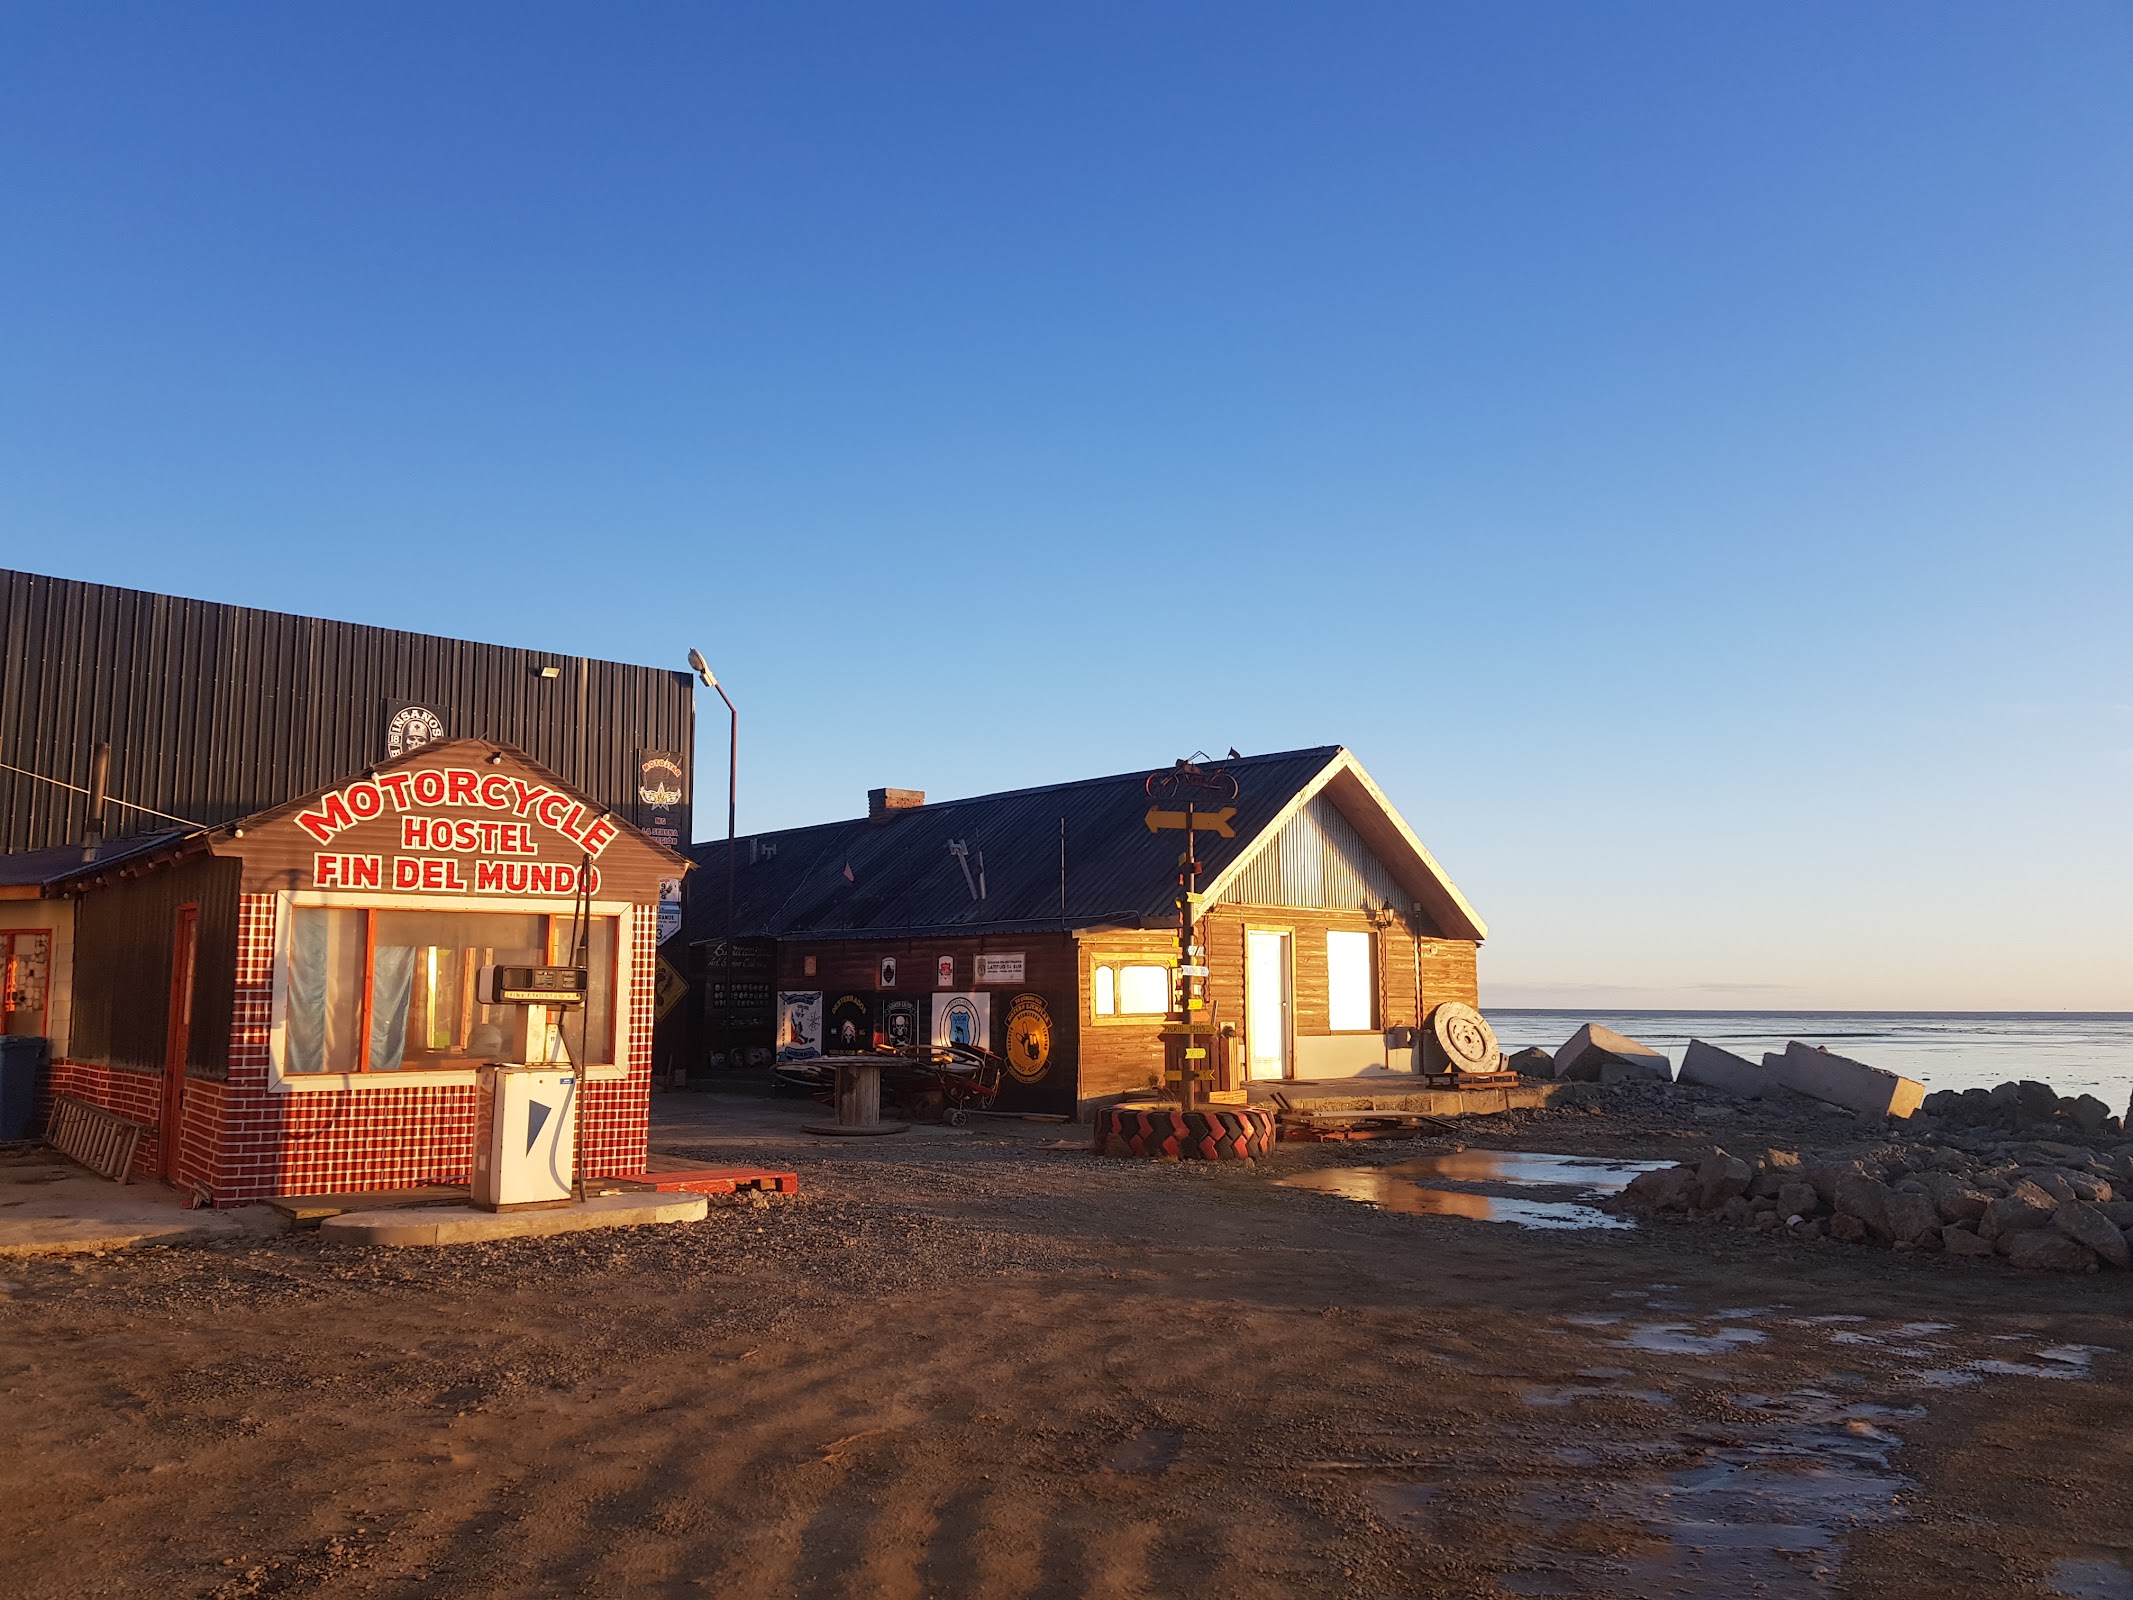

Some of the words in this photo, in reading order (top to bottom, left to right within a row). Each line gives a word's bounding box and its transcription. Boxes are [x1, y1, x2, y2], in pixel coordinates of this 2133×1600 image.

[391, 710, 442, 737] INSANOS
[294, 768, 619, 859] MOTORCYCLE
[401, 815, 538, 855] HOSTEL
[651, 827, 678, 837] SERENA
[312, 852, 383, 889] FIN
[392, 856, 467, 892] DEL
[474, 860, 601, 896] MUNDO
[1164, 1025, 1184, 1033] MADRID
